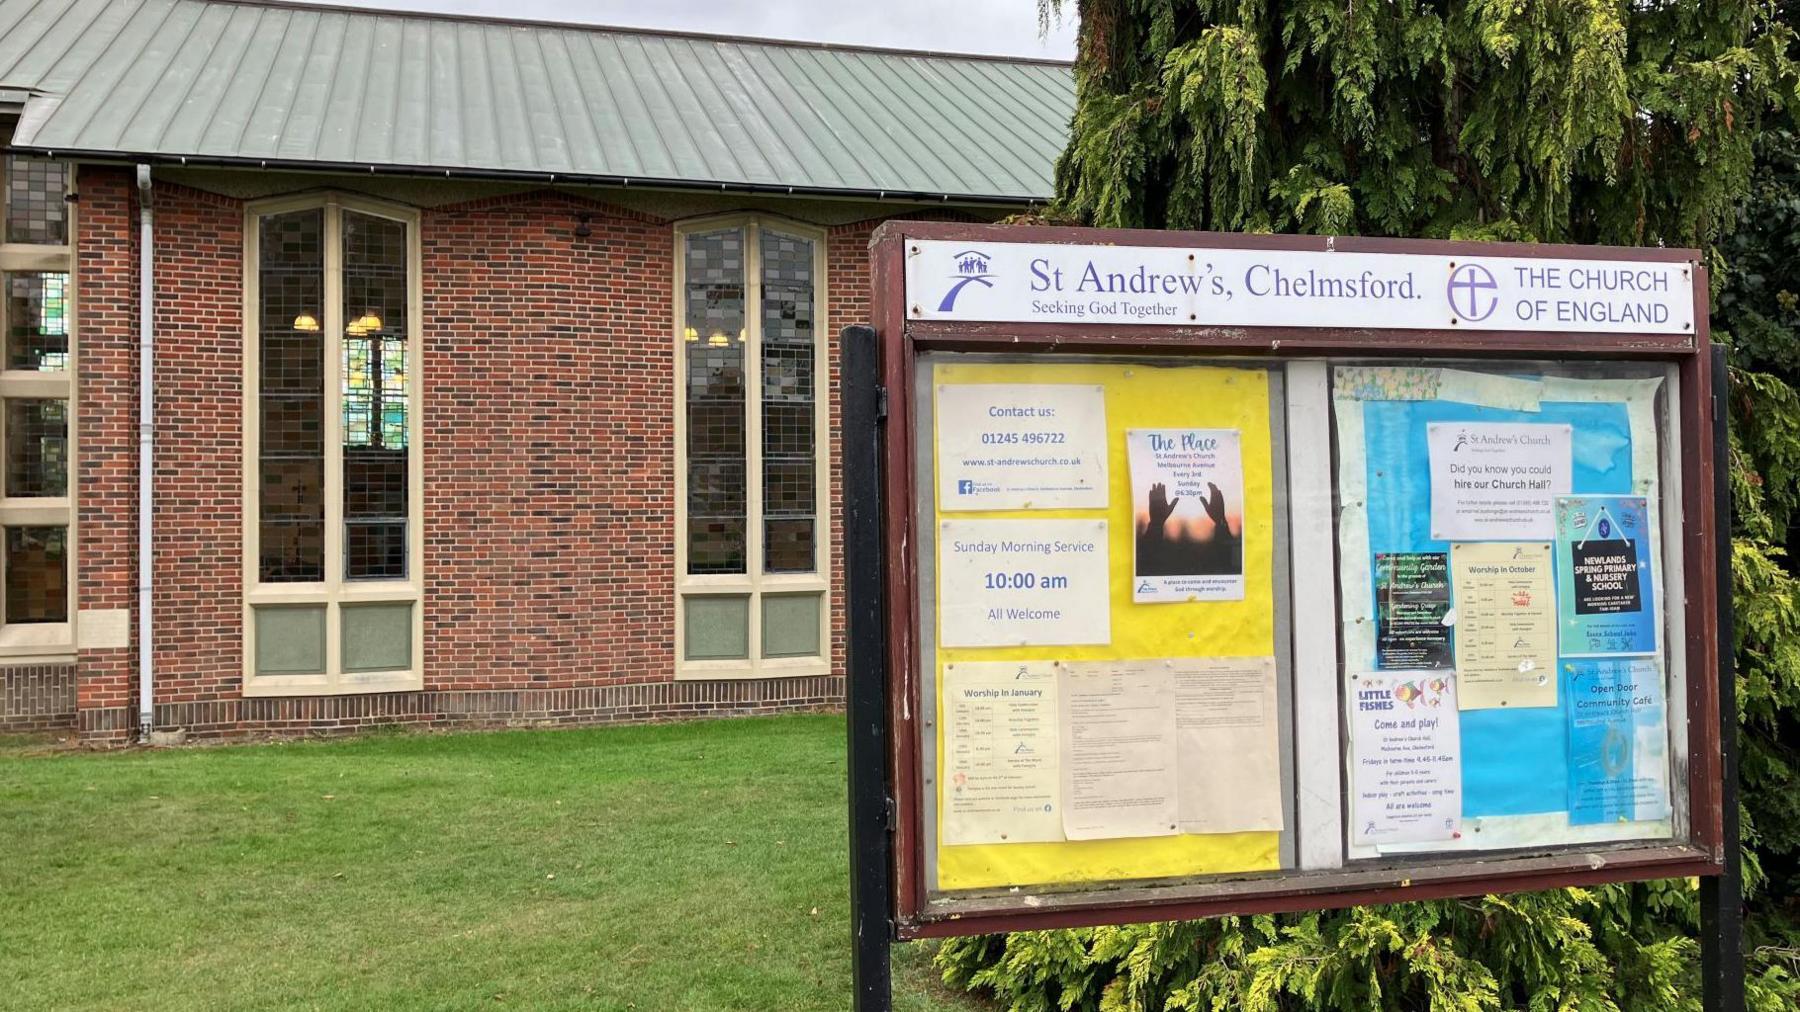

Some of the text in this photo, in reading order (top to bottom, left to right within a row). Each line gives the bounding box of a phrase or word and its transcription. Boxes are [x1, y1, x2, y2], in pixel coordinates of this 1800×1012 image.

[1030, 258, 1422, 302] St Andrew's, Chelmsford.
[1514, 266, 1668, 292] THE CHURCH
[1032, 300, 1178, 318] Seeking God Together
[1516, 300, 1669, 323] OF ENGLAND
[989, 406, 1055, 417] Contact us:
[982, 433, 1065, 444] 01245 496722
[1148, 432, 1217, 451] The Place
[1470, 434, 1551, 445] St Andrew's Church
[962, 457, 1081, 467] www.st-andrewschurch.co.uk
[1173, 471, 1190, 479] Every
[1450, 464, 1552, 476] Did you know you could
[1177, 480, 1200, 488] Sunday
[1454, 479, 1552, 489] hire our Church Hall?
[954, 541, 1094, 555] Sunday Morning Service
[1584, 555, 1627, 566] NEWLANDS
[1420, 562, 1447, 574] Garden
[1468, 566, 1499, 575] Worship
[1508, 565, 1536, 574] October
[1575, 563, 1637, 575] SPRING PRIMARY
[984, 572, 1068, 589] 10:00 am
[1586, 572, 1628, 582] & NURSERY
[1420, 581, 1445, 589] Church
[1591, 581, 1624, 591] SCHOOL
[988, 609, 1061, 620] All Welcome
[964, 689, 1000, 699] Worship
[1010, 688, 1043, 698] January
[1590, 683, 1638, 694] Open Door
[1358, 690, 1391, 701] LITTLE
[1359, 700, 1394, 711] FISHES
[1576, 698, 1631, 709] Community
[1374, 716, 1439, 730] Come and play!
[1362, 758, 1382, 766] Fridays
